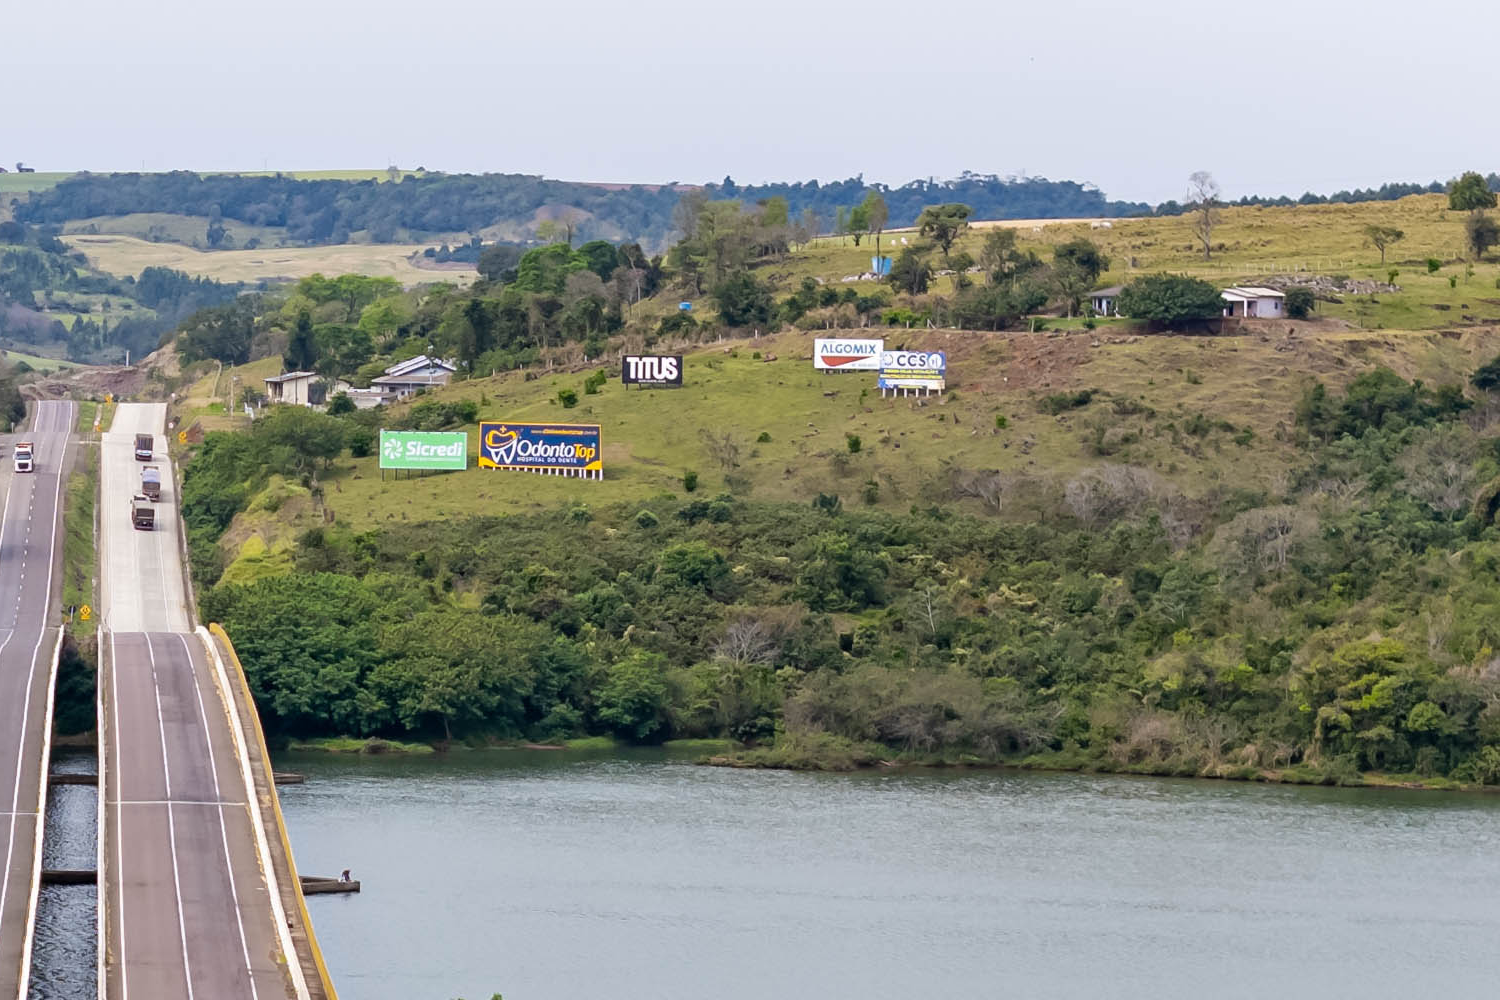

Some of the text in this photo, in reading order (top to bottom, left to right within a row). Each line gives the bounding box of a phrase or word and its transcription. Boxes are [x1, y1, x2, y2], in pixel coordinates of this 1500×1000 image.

[821, 343, 876, 354] ALGOMIX
[897, 354, 926, 367] CCS
[626, 357, 678, 380] TITUS
[406, 441, 463, 456] Sicredi
